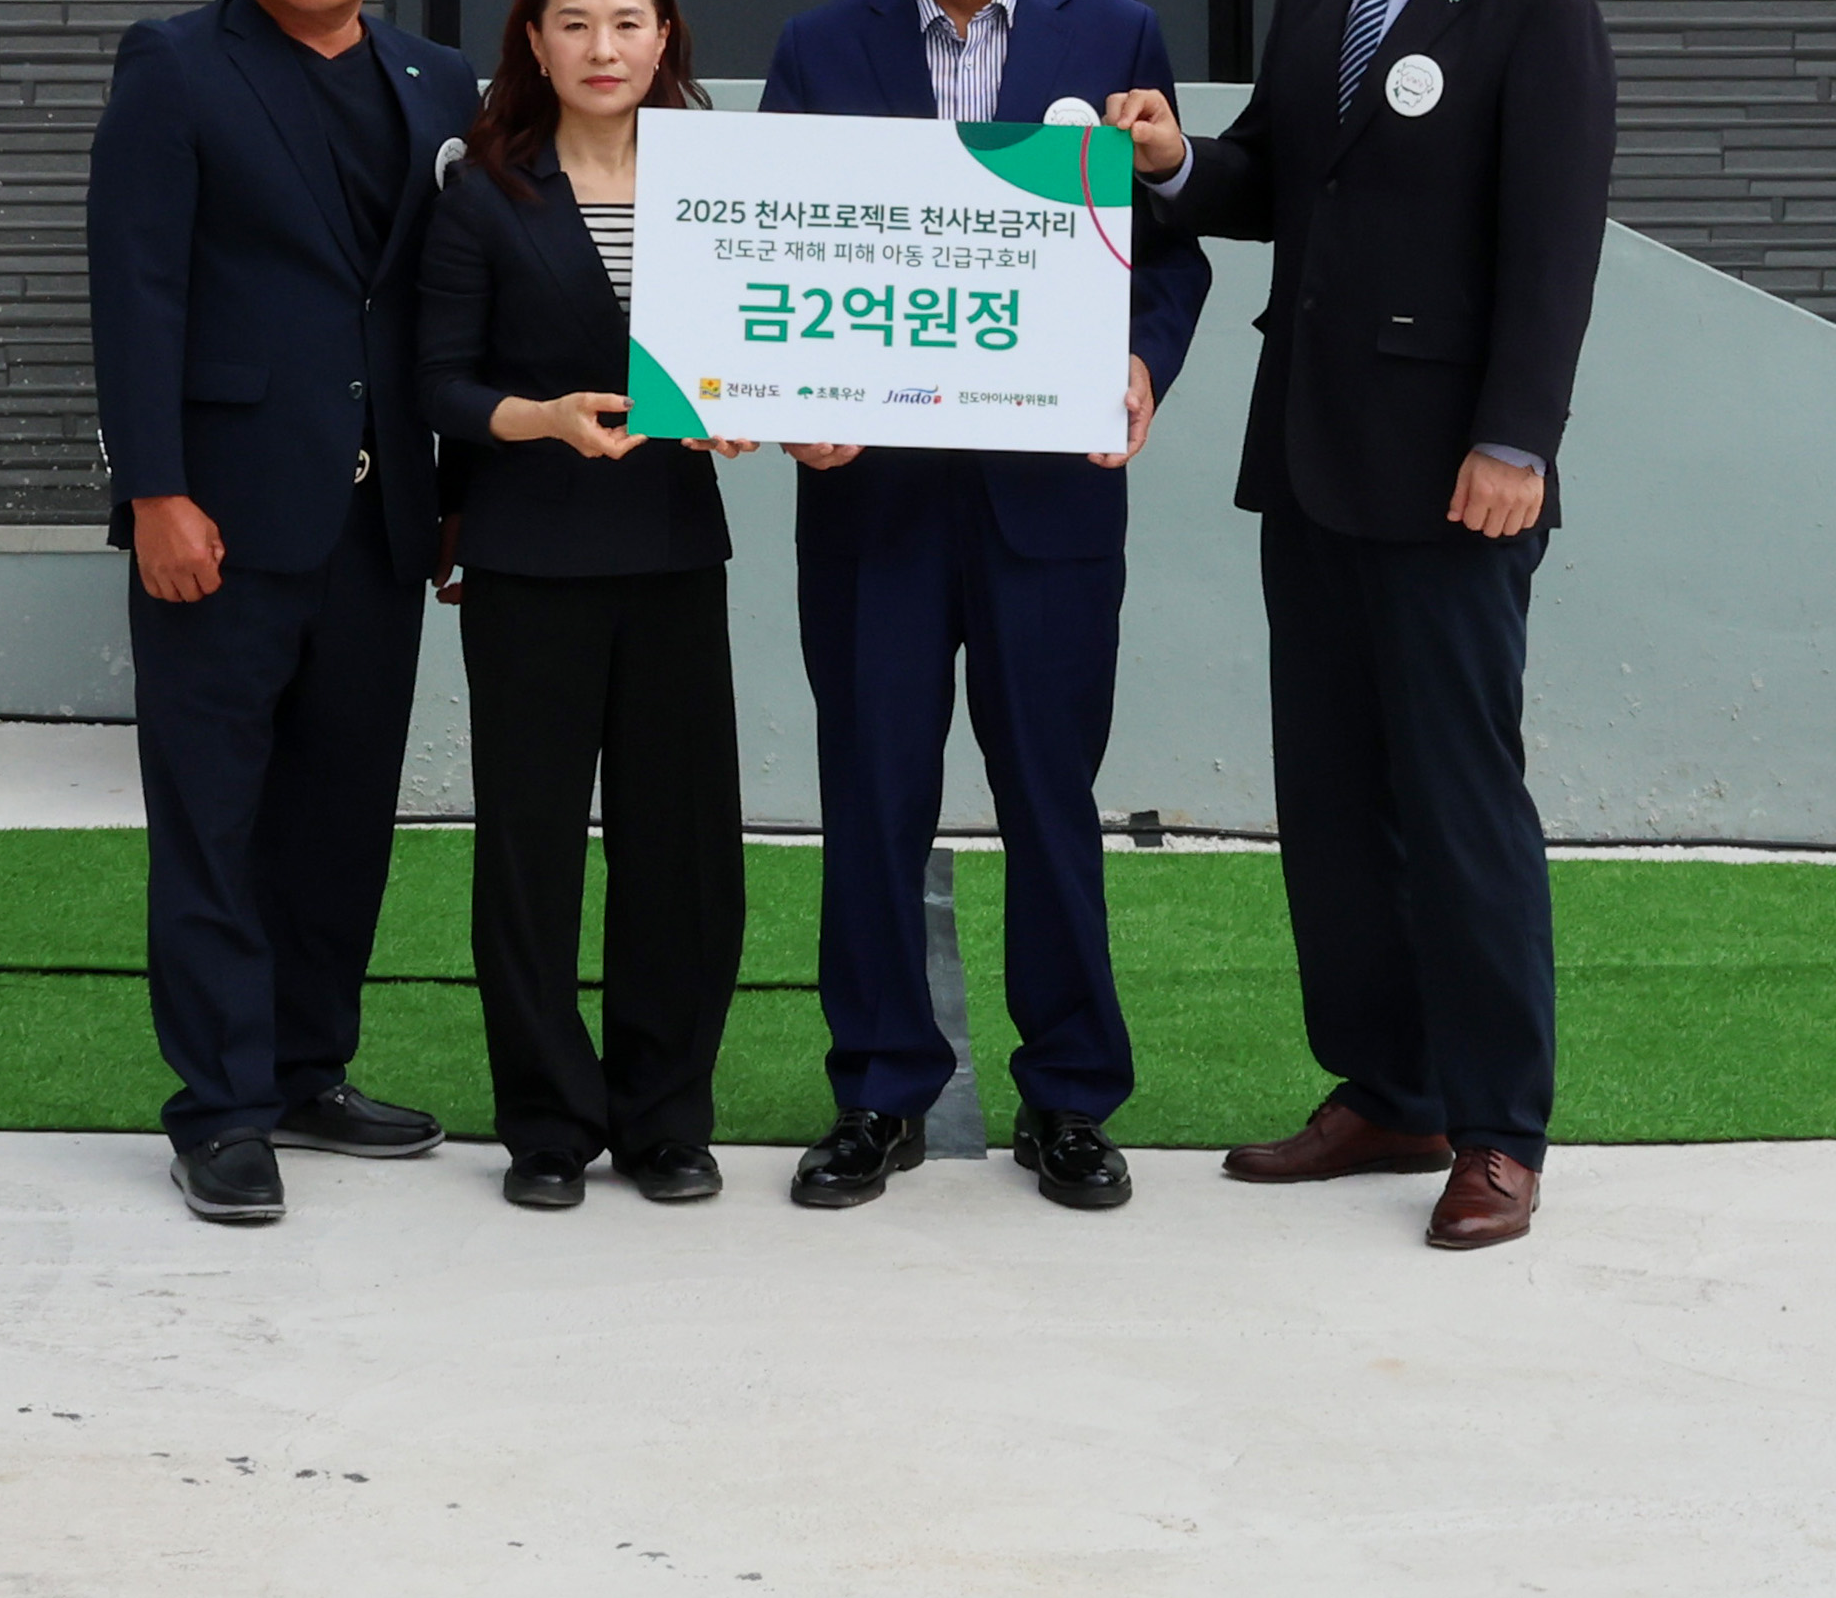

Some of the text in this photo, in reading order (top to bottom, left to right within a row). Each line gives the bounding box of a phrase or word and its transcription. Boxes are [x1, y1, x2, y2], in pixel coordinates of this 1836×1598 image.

[675, 198, 1076, 239] 2025 천사프로젝트 천사보금자리
[714, 238, 1036, 270] 진도군 재해 피해 아동 긴급구호비
[738, 282, 1019, 351] 금2억원정
[726, 382, 780, 398] 전라남도
[816, 386, 866, 402] 초록우산
[883, 389, 931, 405] Jindo
[958, 391, 1058, 407] 진도아이사랑위원회
